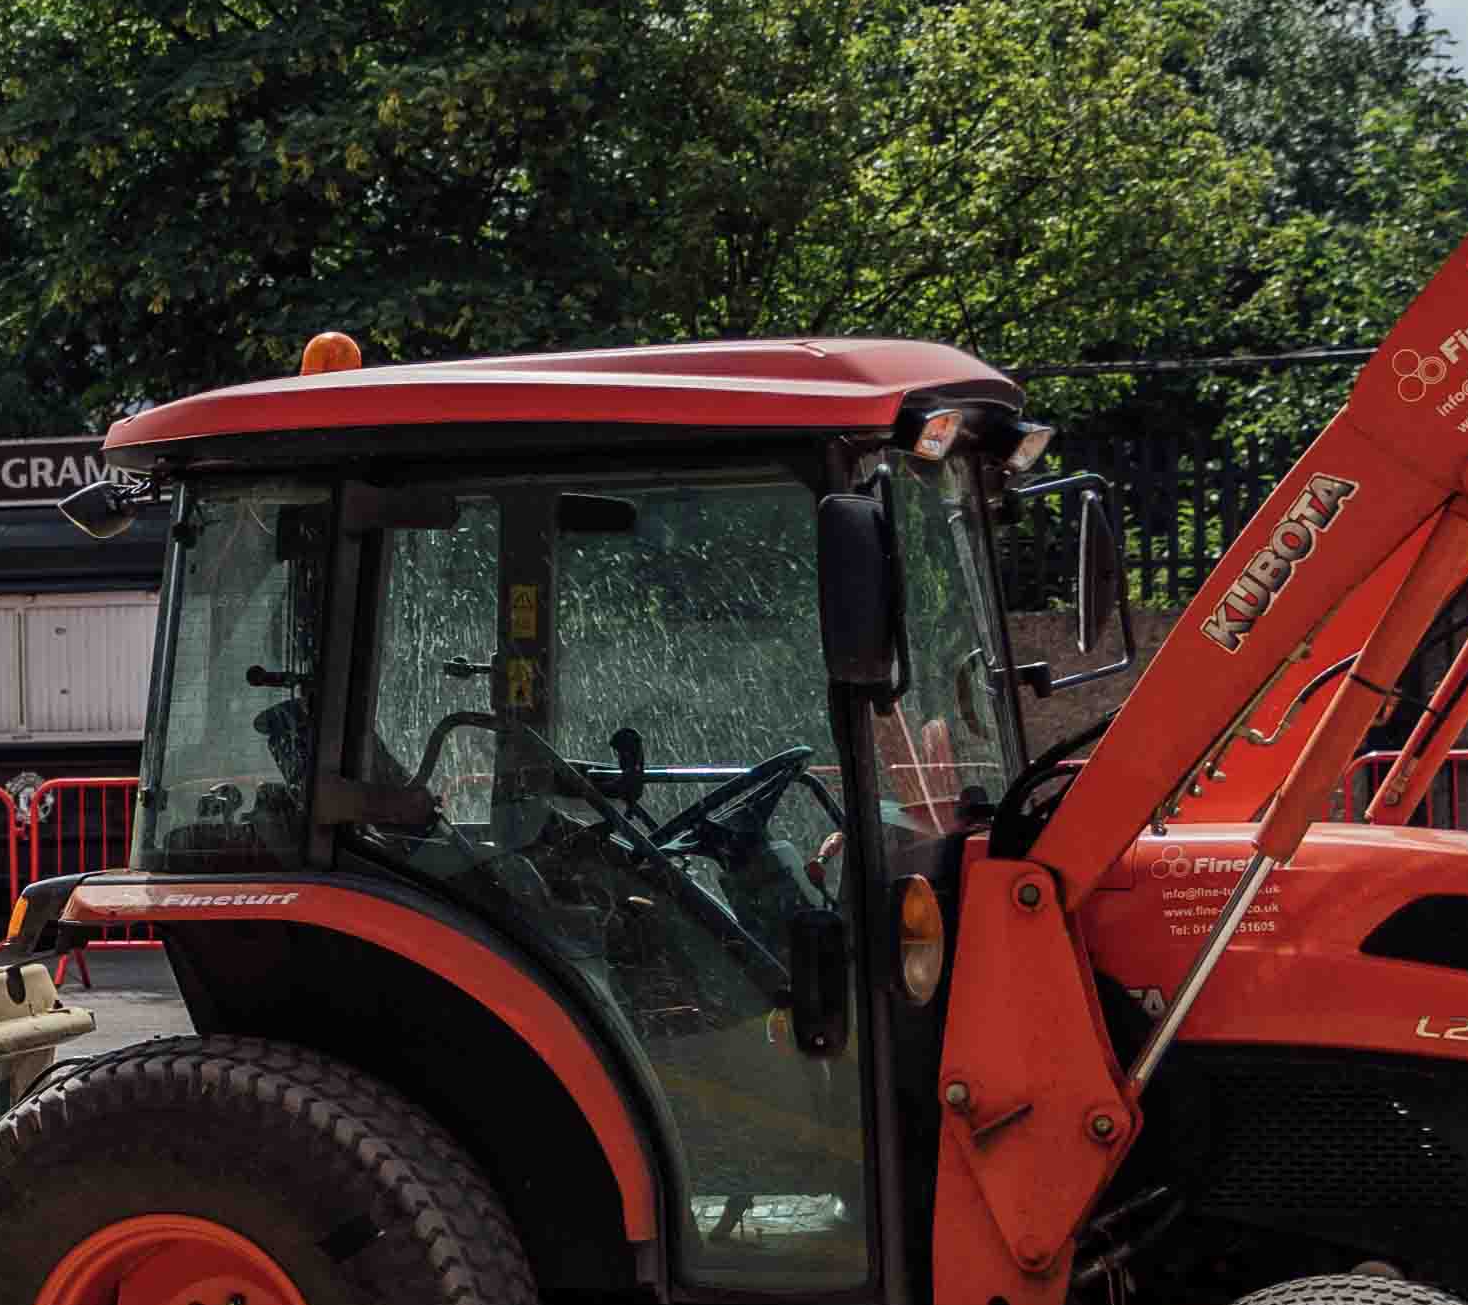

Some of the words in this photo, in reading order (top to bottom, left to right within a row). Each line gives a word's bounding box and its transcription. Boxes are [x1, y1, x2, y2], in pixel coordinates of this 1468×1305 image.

[1200, 472, 1360, 655] KUBOTA
[163, 892, 299, 906] Fineturf
[1169, 924, 1191, 936] Tel:
